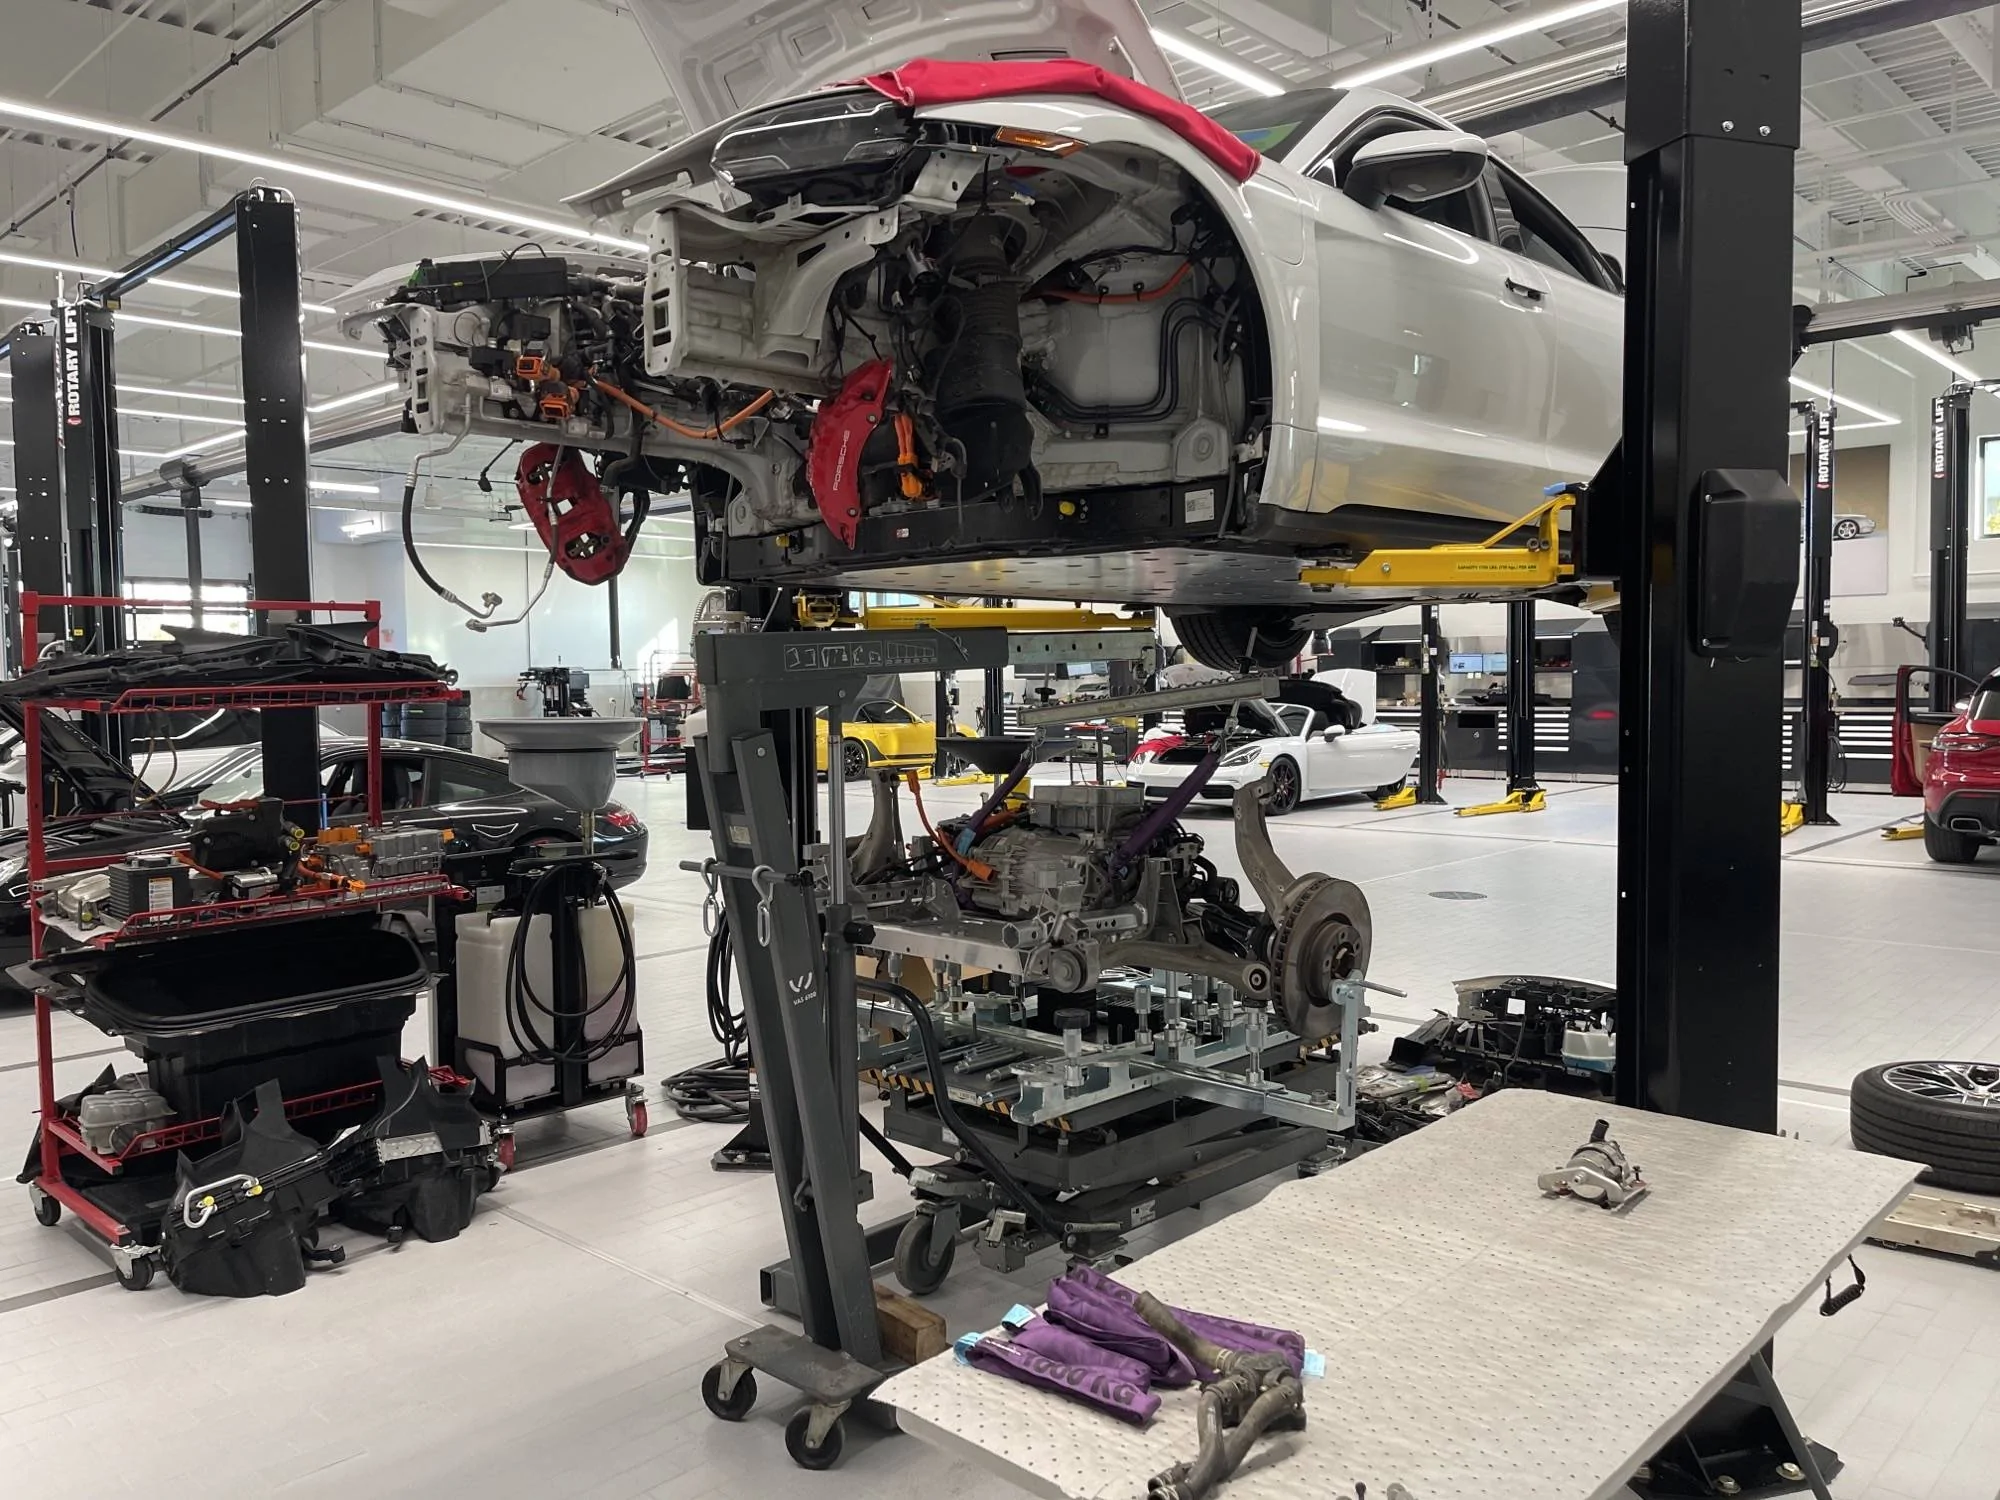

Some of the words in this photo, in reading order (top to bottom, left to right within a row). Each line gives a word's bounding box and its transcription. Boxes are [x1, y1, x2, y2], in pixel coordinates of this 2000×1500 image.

[65, 306, 78, 344] LIFT
[66, 347, 80, 416] ROTARY
[1819, 411, 1830, 436] LIFT
[1934, 398, 1944, 423] LIFT
[833, 430, 850, 491] PORSCHE
[1818, 437, 1829, 483] ROTARY
[1935, 425, 1944, 473] ROTARY
[1090, 1375, 1142, 1406] KG
